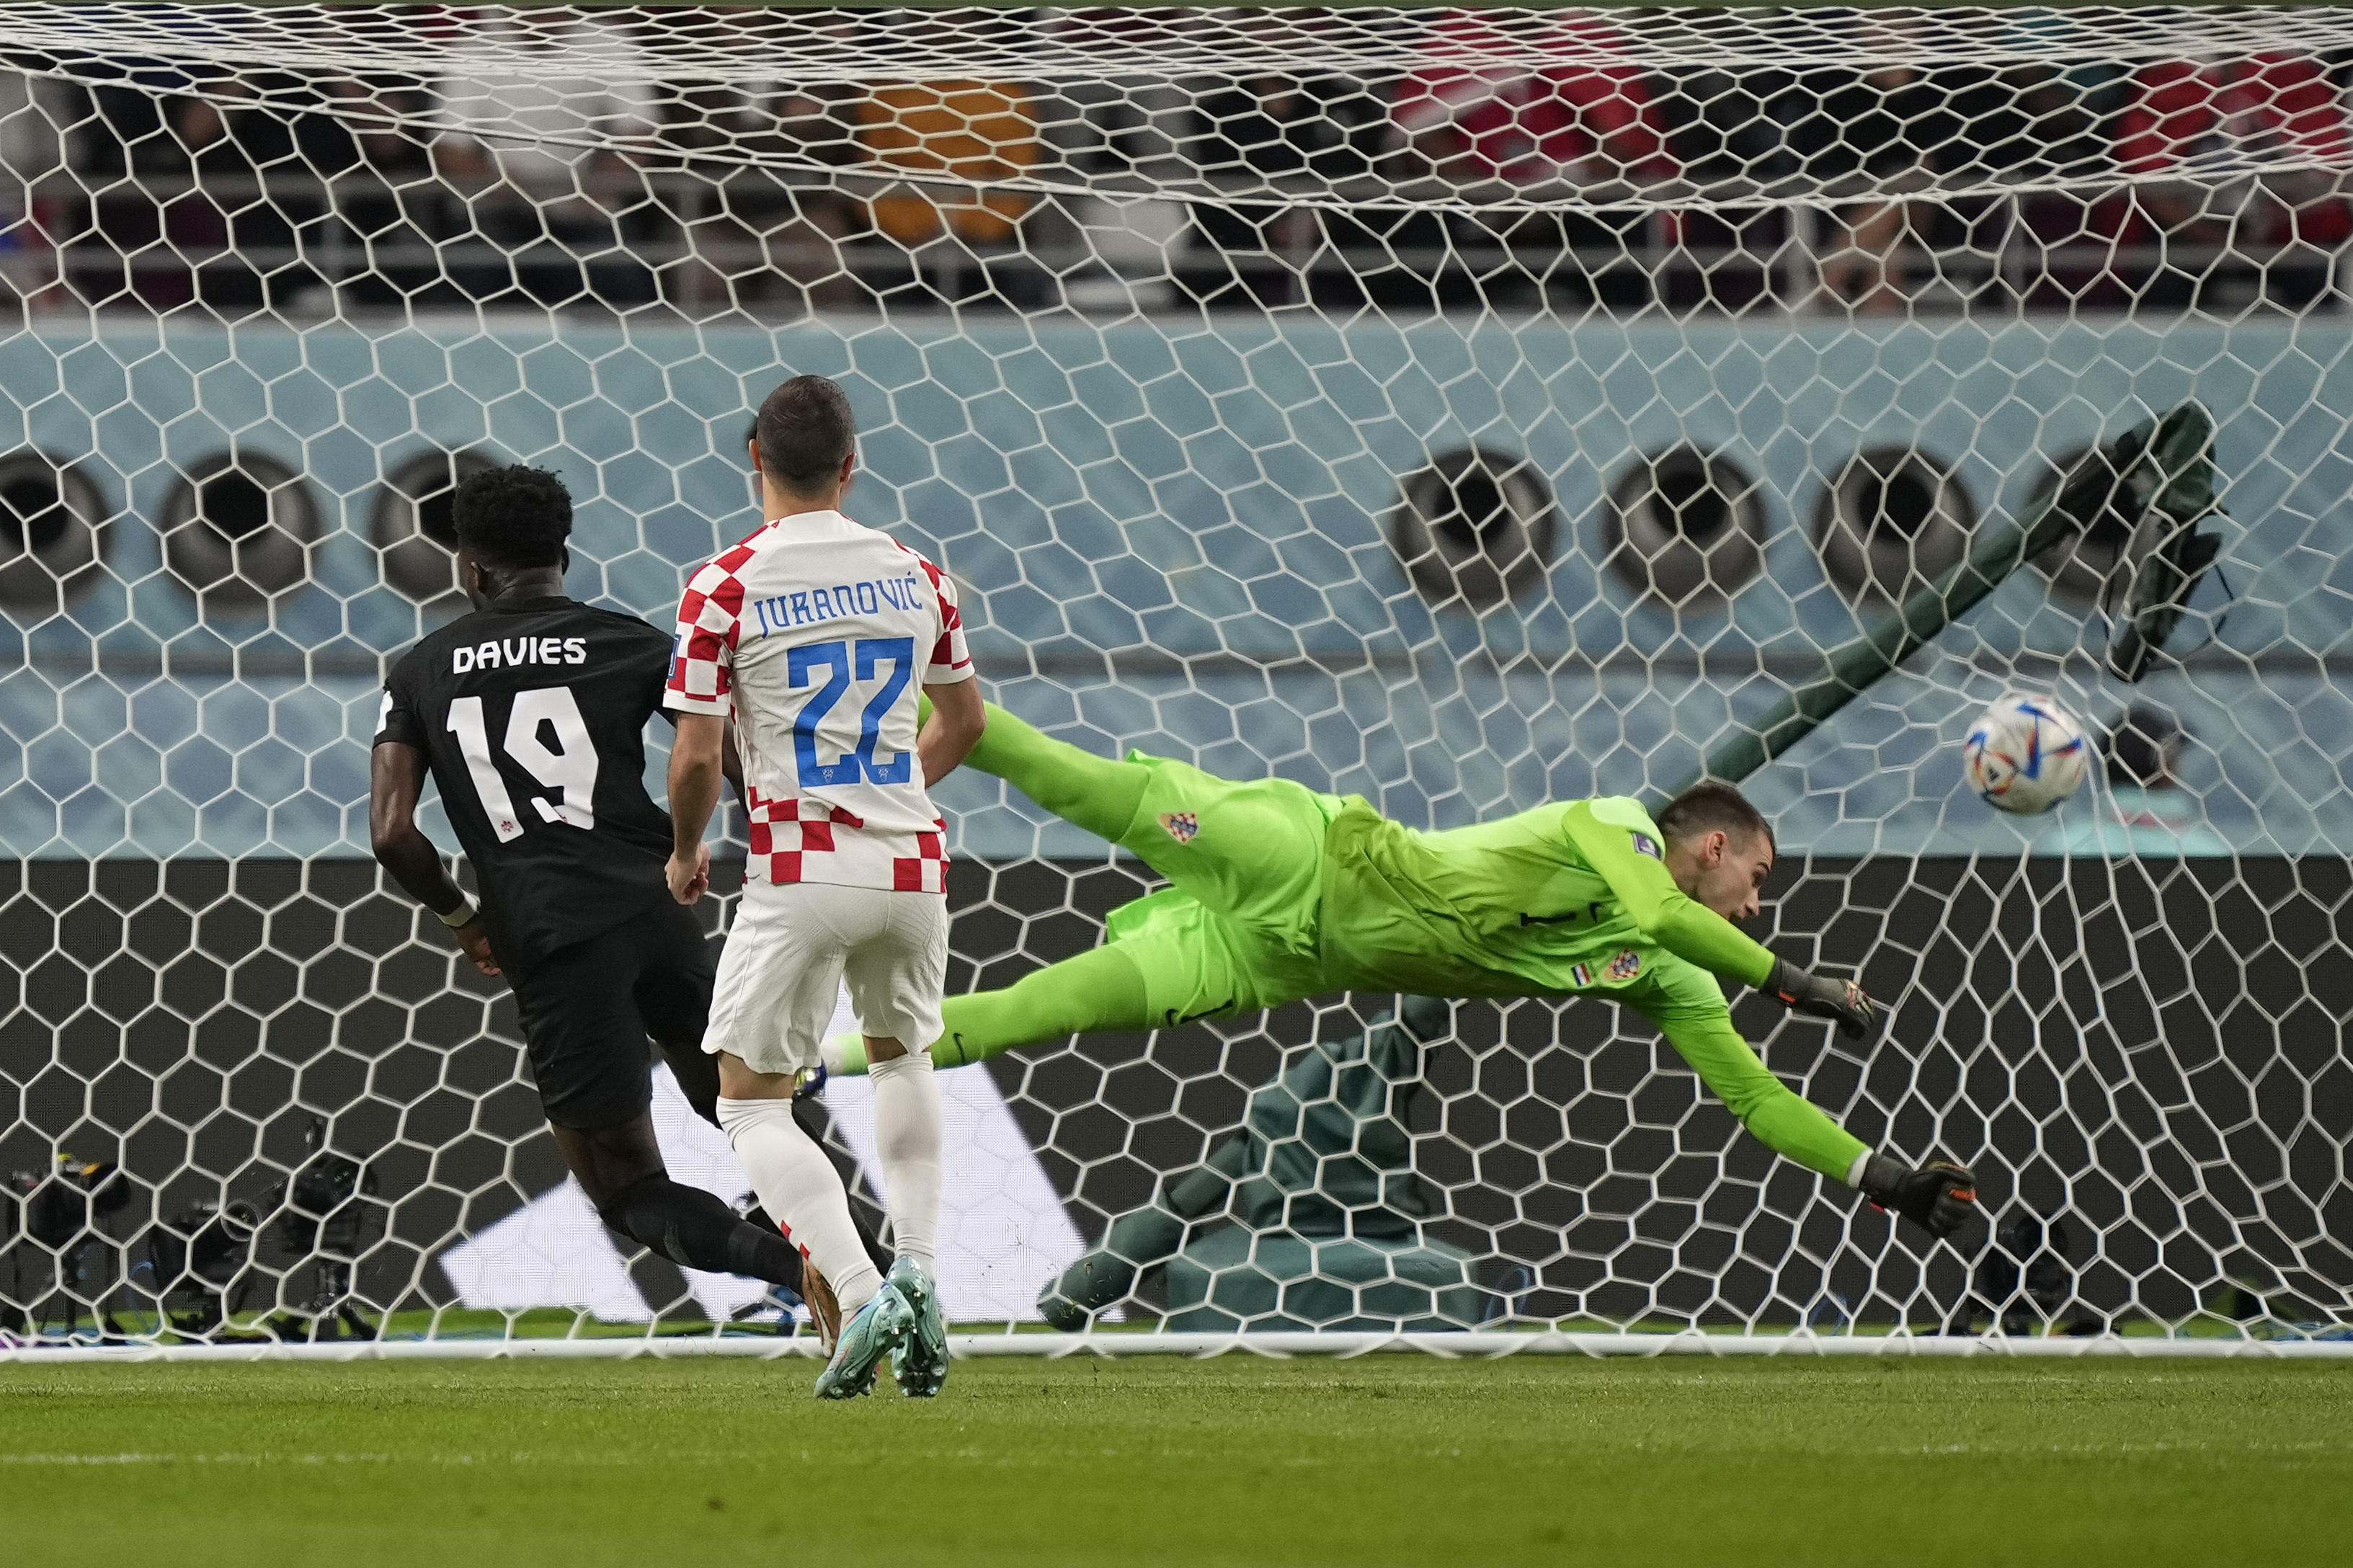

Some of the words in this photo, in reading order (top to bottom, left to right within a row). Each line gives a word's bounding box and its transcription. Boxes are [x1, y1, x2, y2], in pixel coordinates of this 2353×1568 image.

[453, 637, 587, 674] DAVIES
[754, 571, 922, 639] JURANOVIĆ
[446, 686, 599, 843] 19
[787, 637, 914, 788] 22
